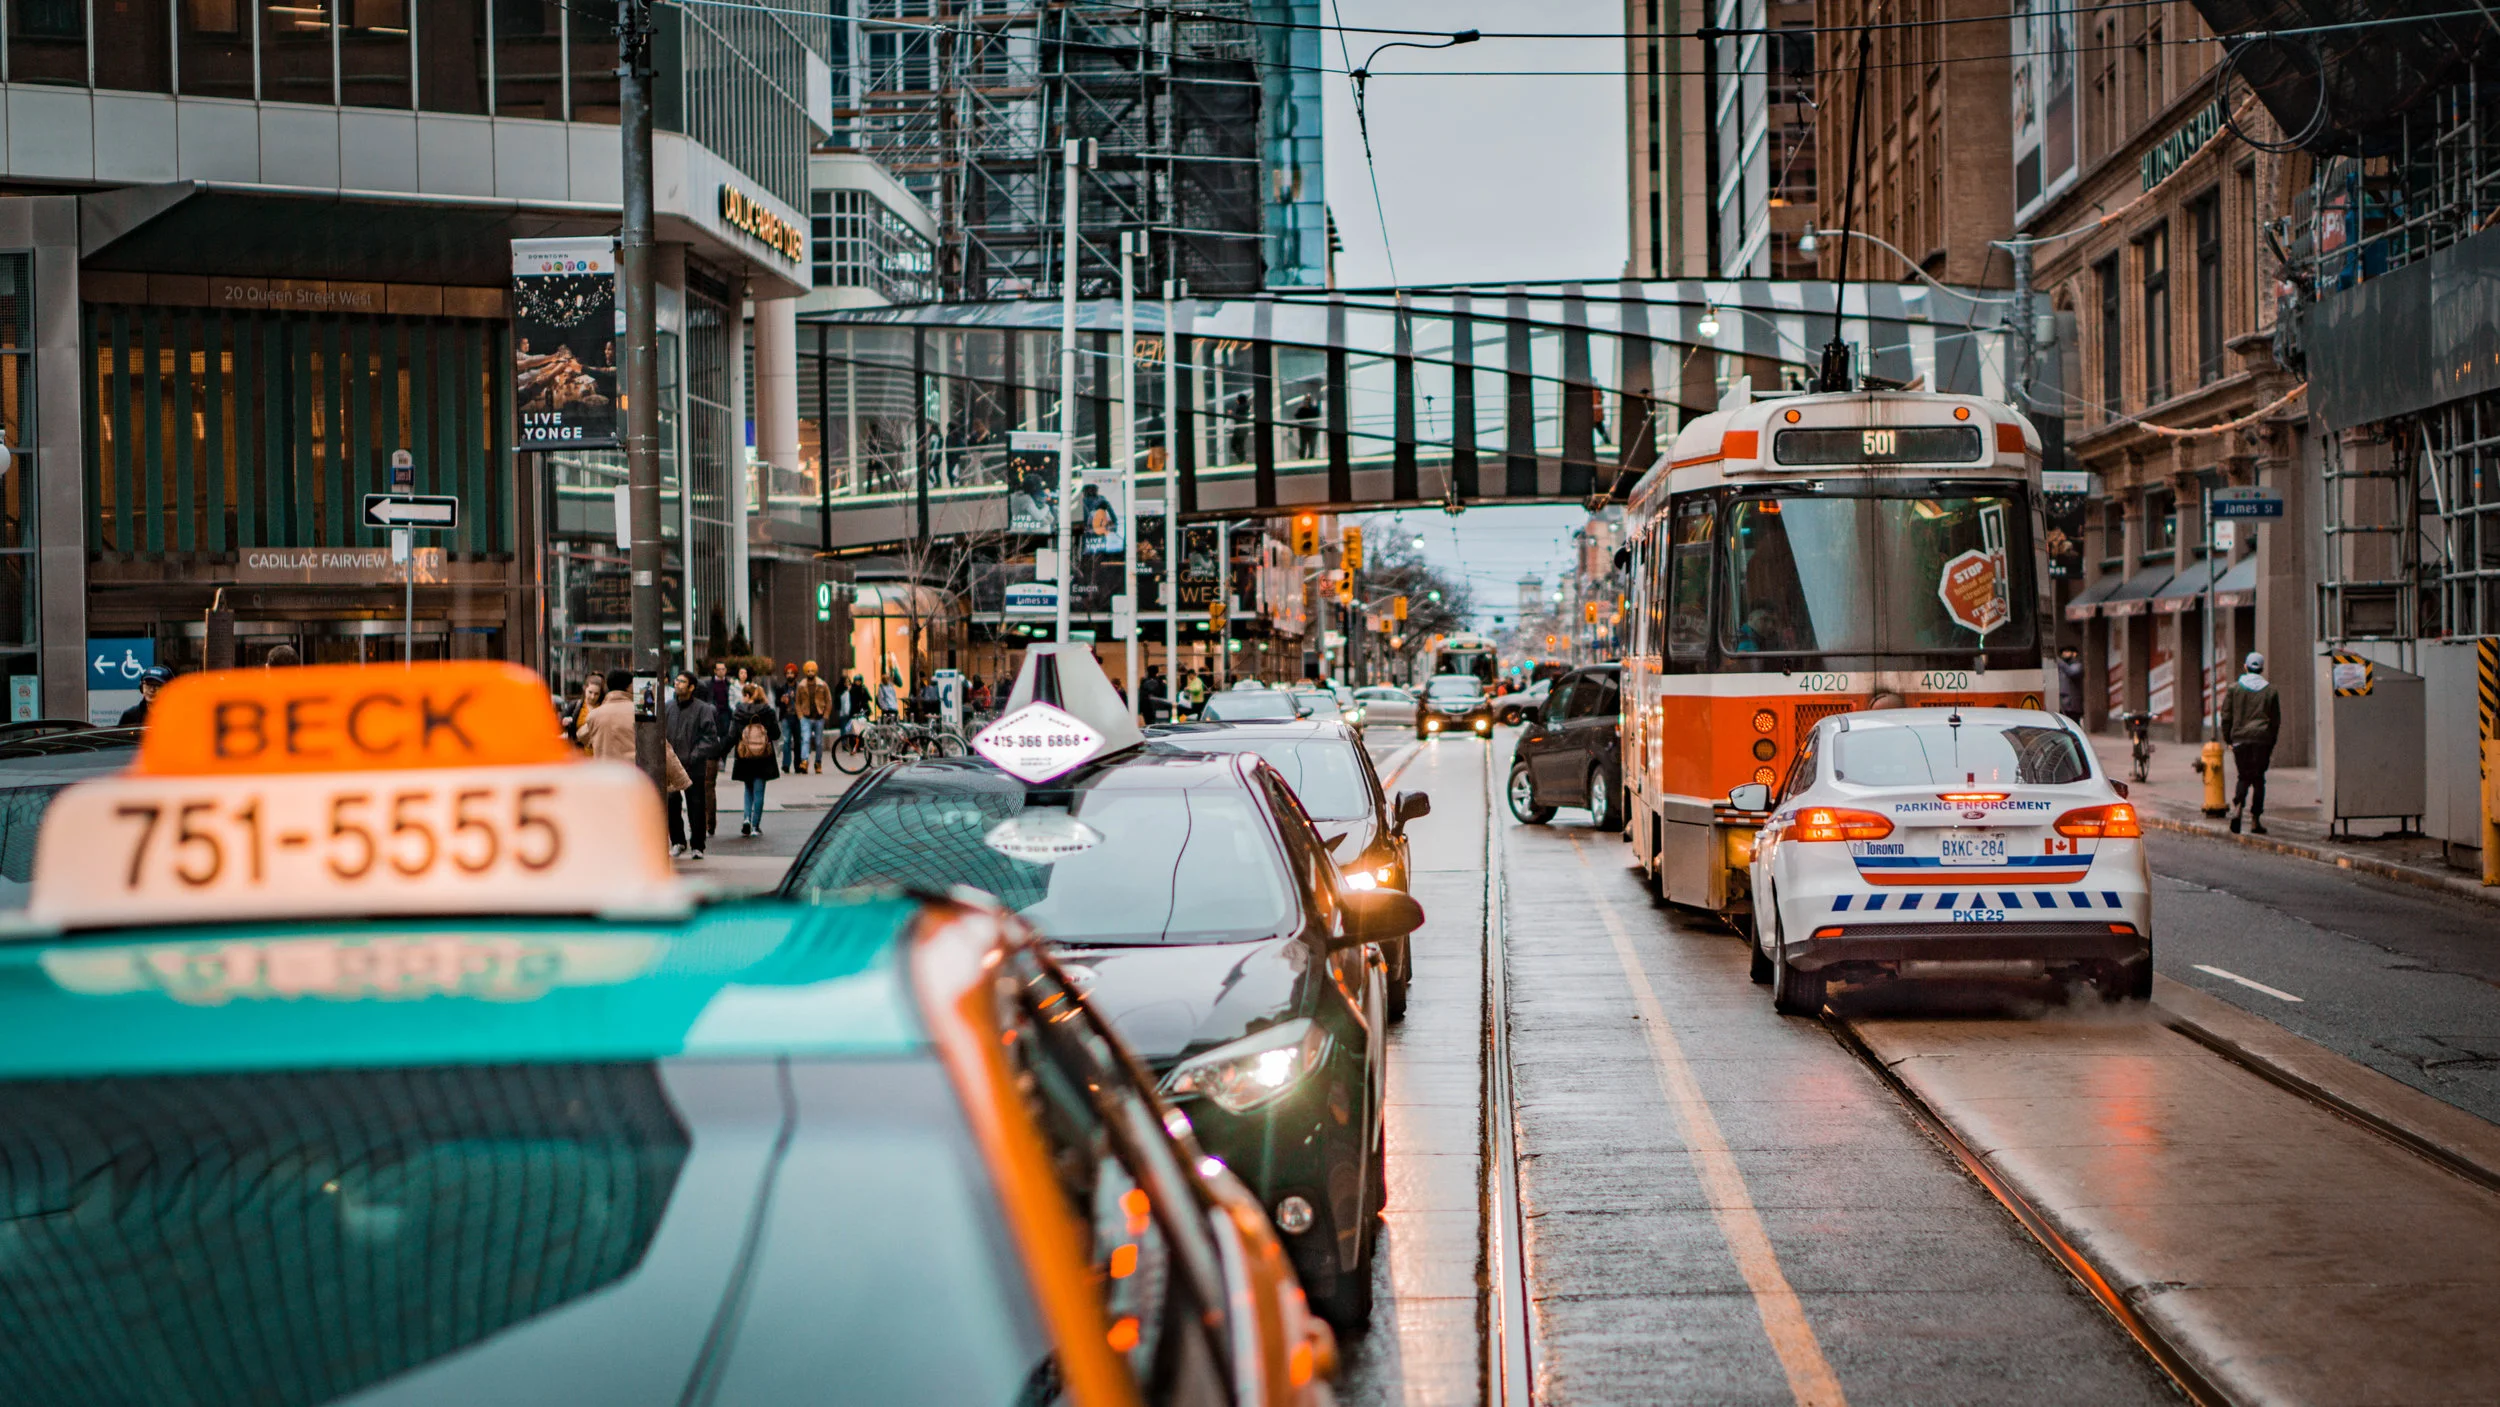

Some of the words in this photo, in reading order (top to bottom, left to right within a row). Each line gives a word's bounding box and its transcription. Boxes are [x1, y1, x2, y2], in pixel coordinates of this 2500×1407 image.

[224, 285, 243, 300] 20
[247, 286, 293, 303] Queen
[296, 288, 336, 305] Street
[339, 290, 371, 306] West
[524, 412, 562, 425] LIVE
[524, 426, 583, 441] YONGE
[1862, 430, 1896, 456] 501
[2224, 503, 2258, 514] James
[2264, 504, 2274, 514] St
[248, 553, 319, 569] CADILLAC
[322, 553, 387, 569] FAIRVIEW
[1953, 561, 1984, 584] STOP
[1799, 674, 1849, 692] 4020
[1921, 671, 1968, 690] 4020
[215, 687, 477, 761] BECK
[1895, 802, 1951, 812] PARKING
[1956, 801, 2051, 811] ENFORCEMENT
[114, 783, 562, 890] 751-5555
[1866, 841, 1905, 855] TORONTO
[1981, 839, 2004, 857] 284
[1952, 910, 2005, 923] PKE25
